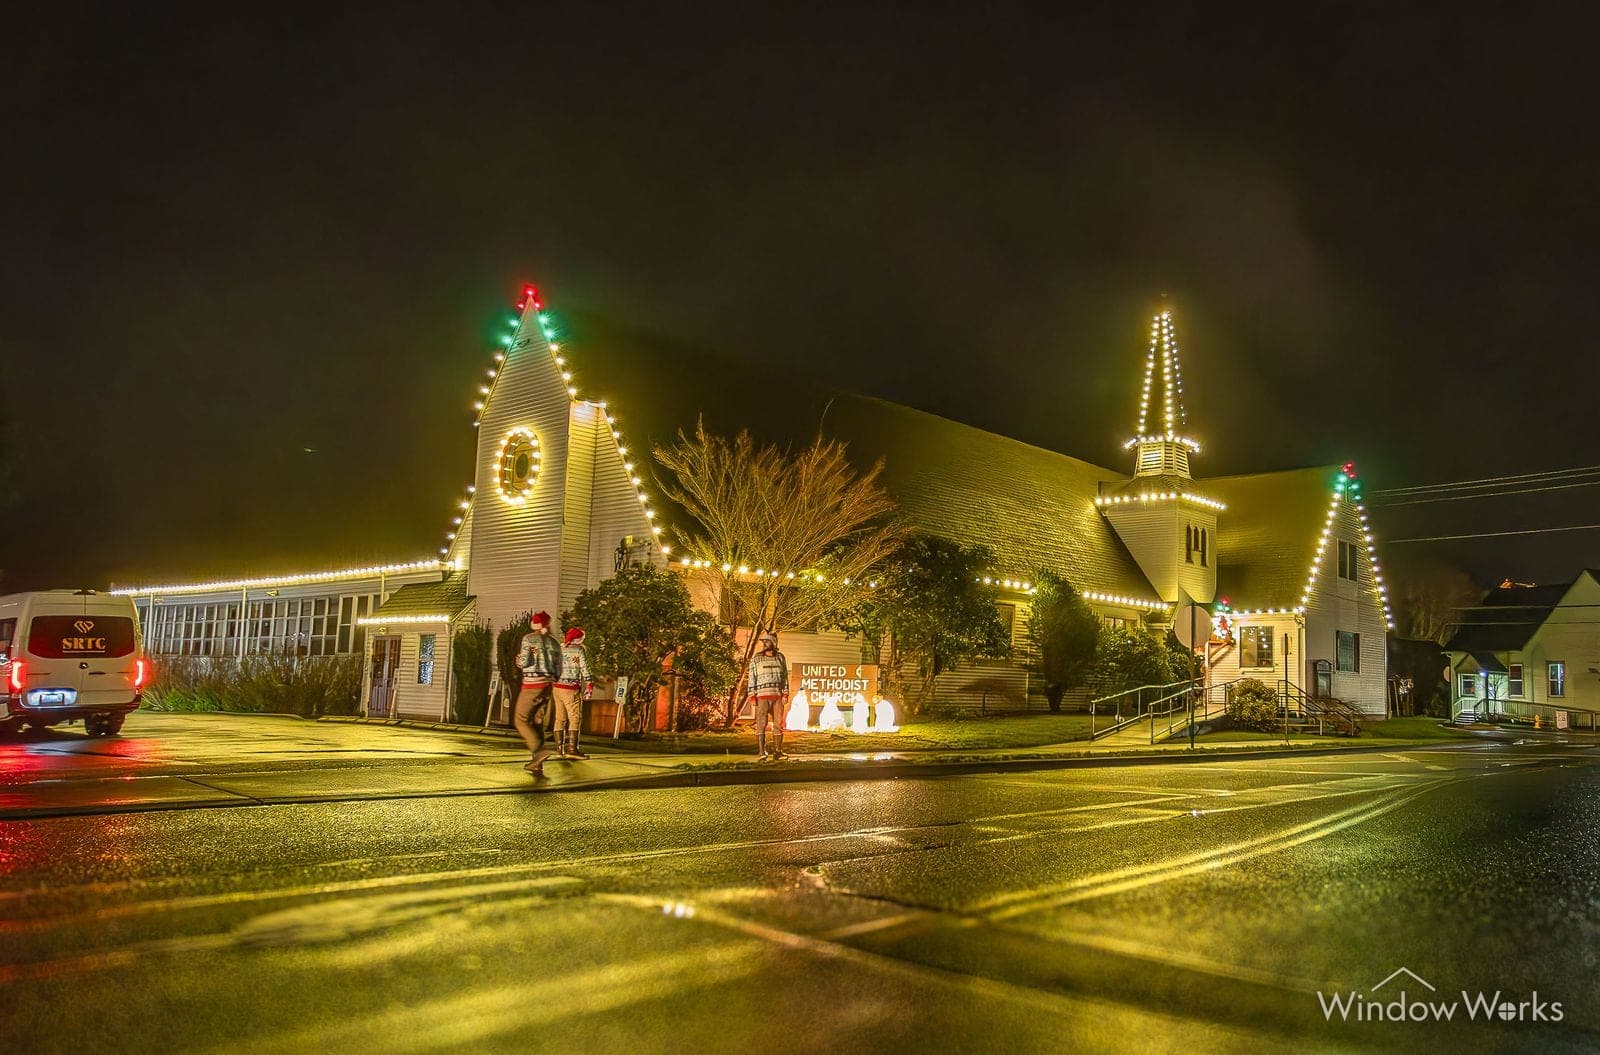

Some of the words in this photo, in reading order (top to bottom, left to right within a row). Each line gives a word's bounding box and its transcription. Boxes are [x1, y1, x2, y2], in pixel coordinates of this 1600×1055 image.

[62, 637, 106, 650] SRTC
[802, 665, 847, 677] UNITED
[801, 678, 870, 691] METHODIST
